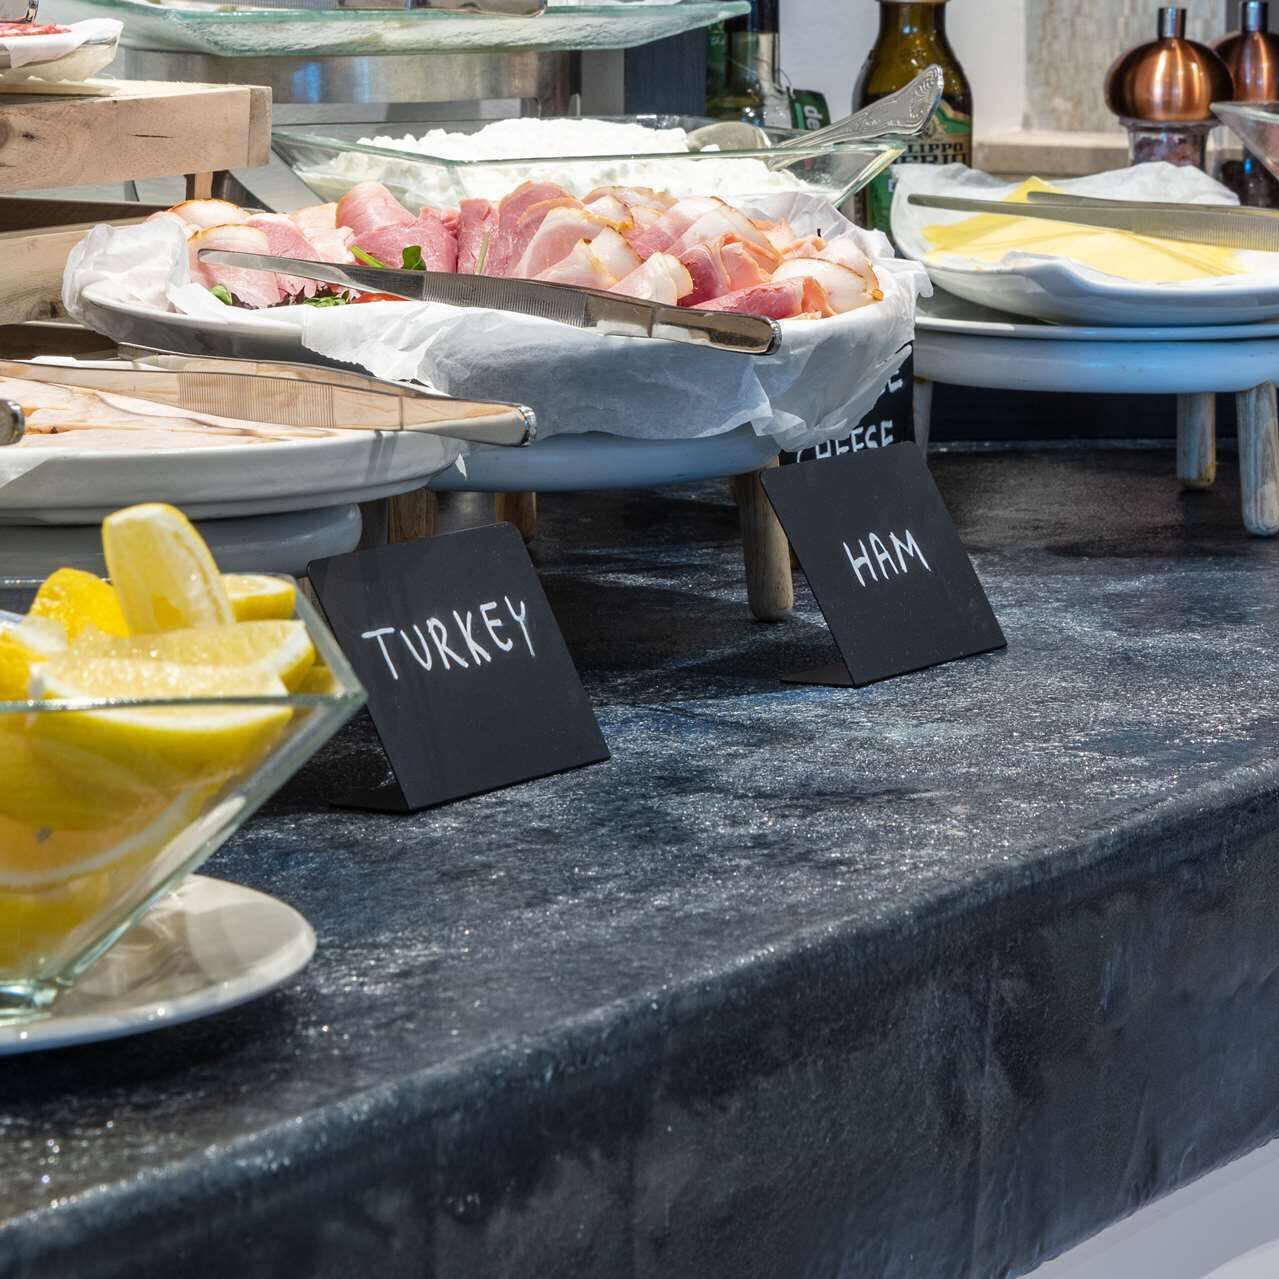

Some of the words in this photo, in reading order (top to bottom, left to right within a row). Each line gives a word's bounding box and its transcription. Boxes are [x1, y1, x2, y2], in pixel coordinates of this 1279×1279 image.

[906, 143, 964, 154] LIPPO
[842, 528, 932, 588] HAM
[360, 594, 537, 681] TURKEY
